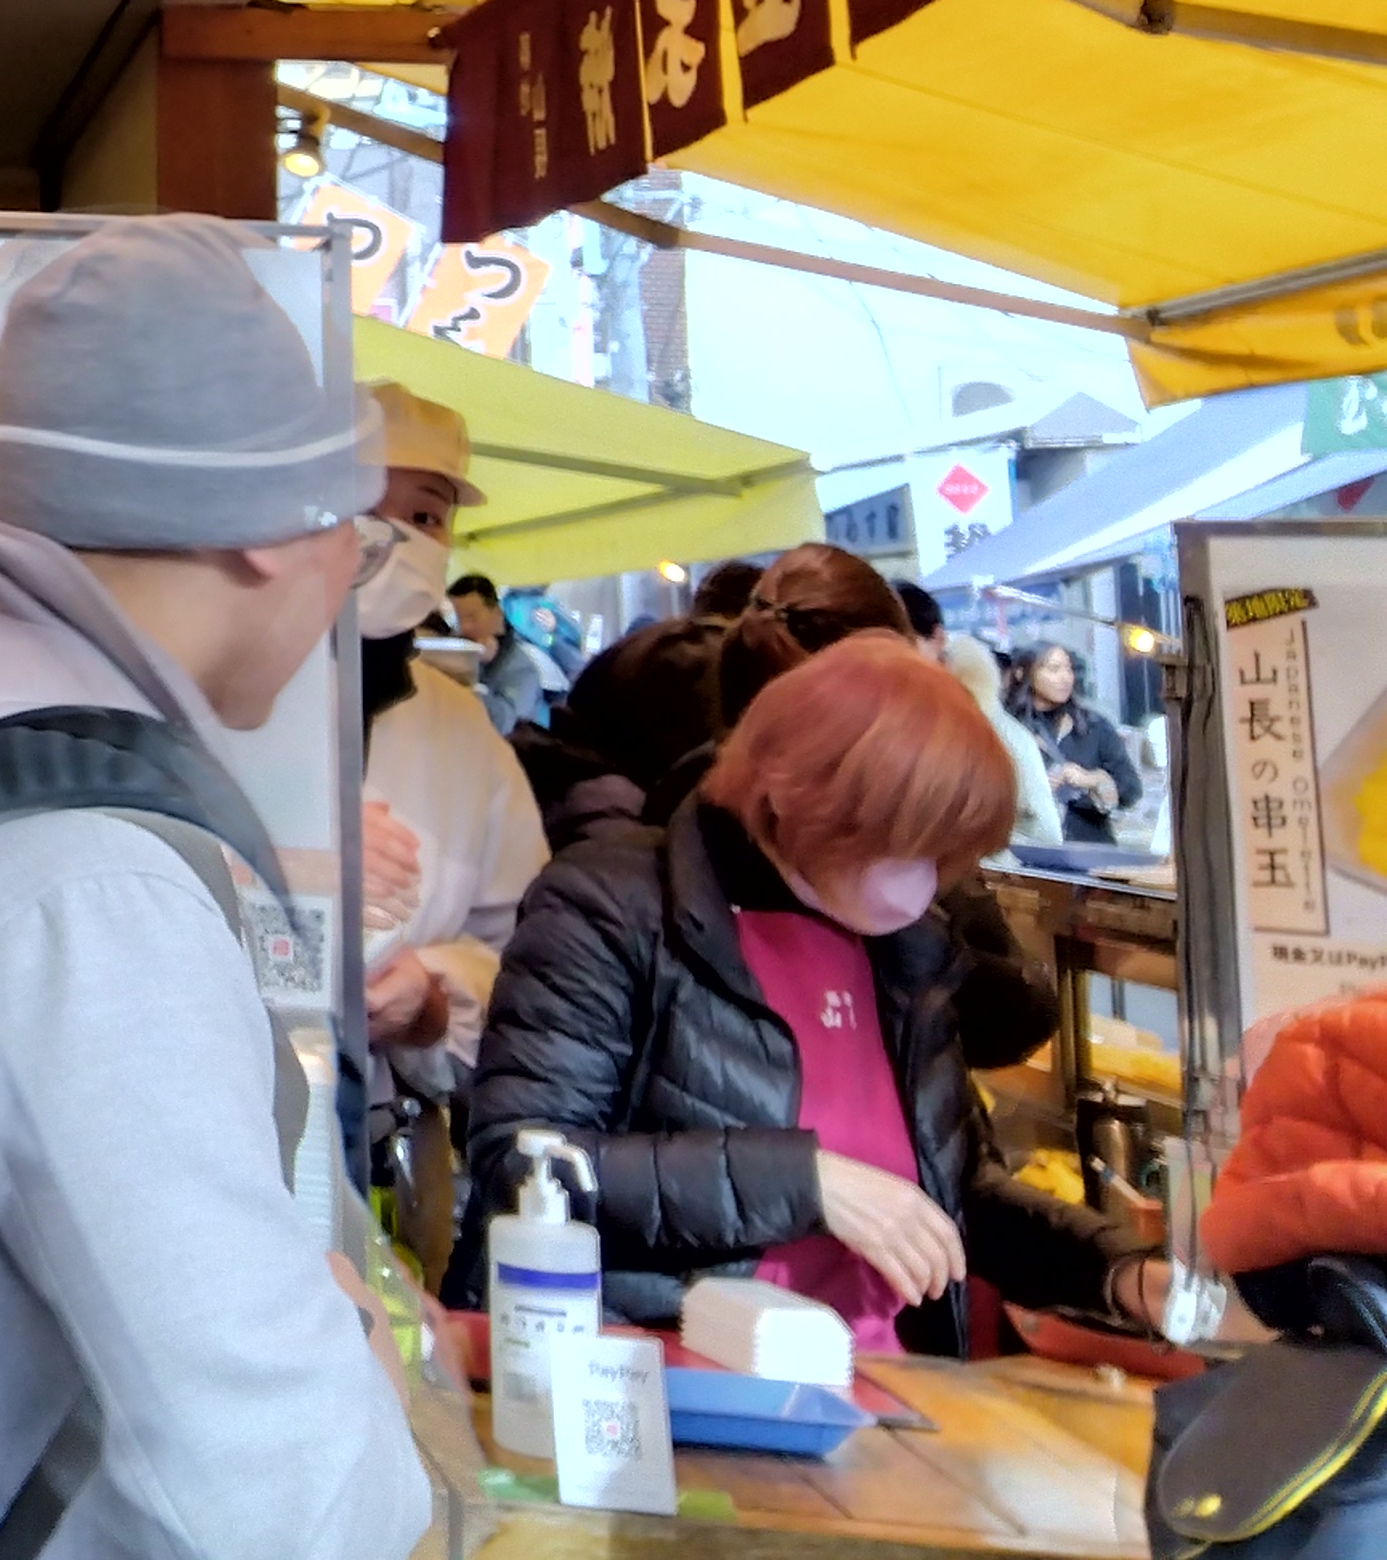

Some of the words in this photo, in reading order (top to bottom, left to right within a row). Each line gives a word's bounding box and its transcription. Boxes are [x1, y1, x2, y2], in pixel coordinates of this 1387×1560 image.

[1239, 650, 1294, 888] 山長の串玉
